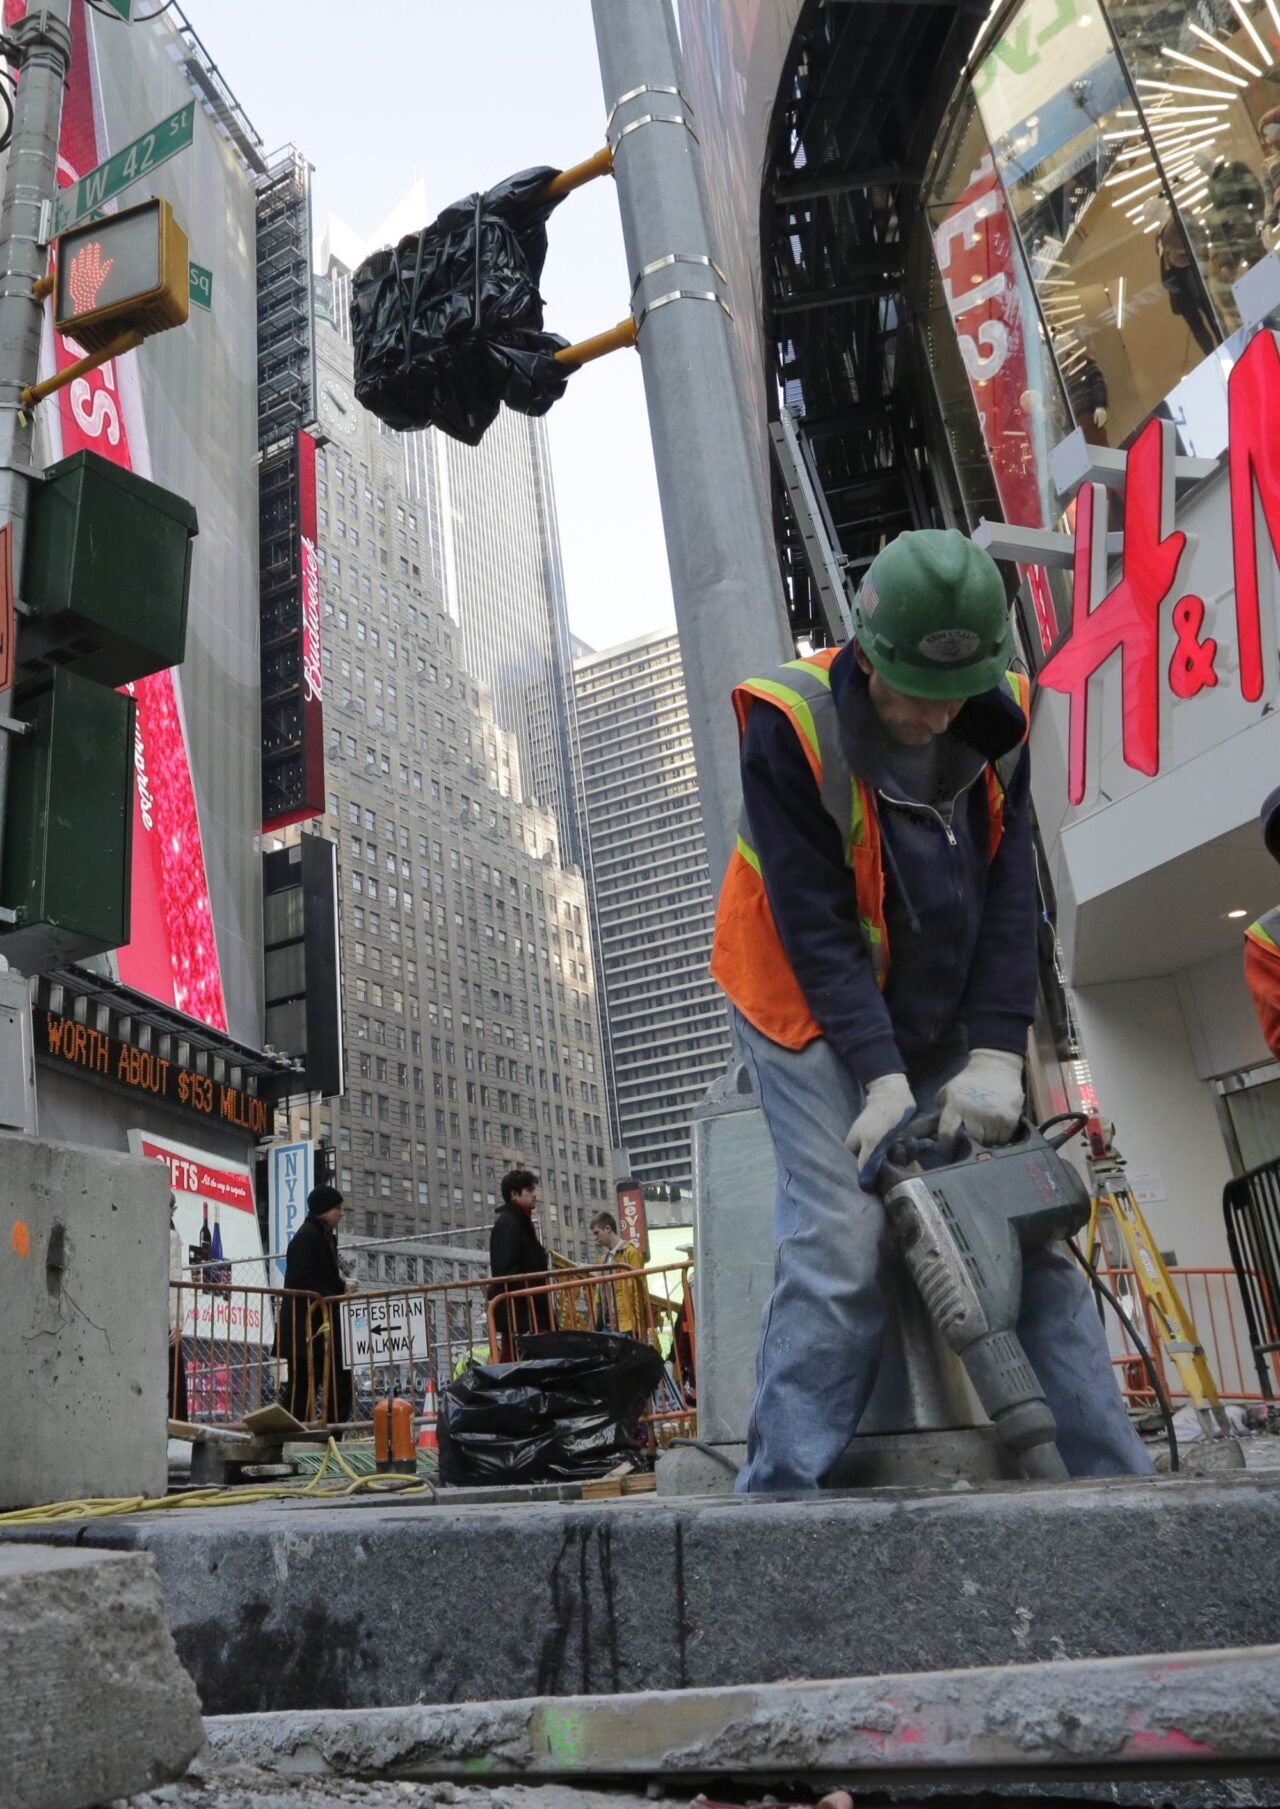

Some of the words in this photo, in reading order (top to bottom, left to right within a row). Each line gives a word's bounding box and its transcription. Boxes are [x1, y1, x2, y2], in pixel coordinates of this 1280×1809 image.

[86, 166, 109, 208] W
[122, 133, 155, 178] 42
[190, 268, 209, 298] Sq
[301, 534, 324, 702] Budweiser
[47, 1011, 109, 1074] WORTH
[118, 1043, 170, 1095] ABOUT
[178, 1068, 213, 1113] $153
[220, 1084, 268, 1134] MILLION
[217, 1304, 261, 1329] HOSTSS
[357, 1335, 416, 1356] WALKWAY
